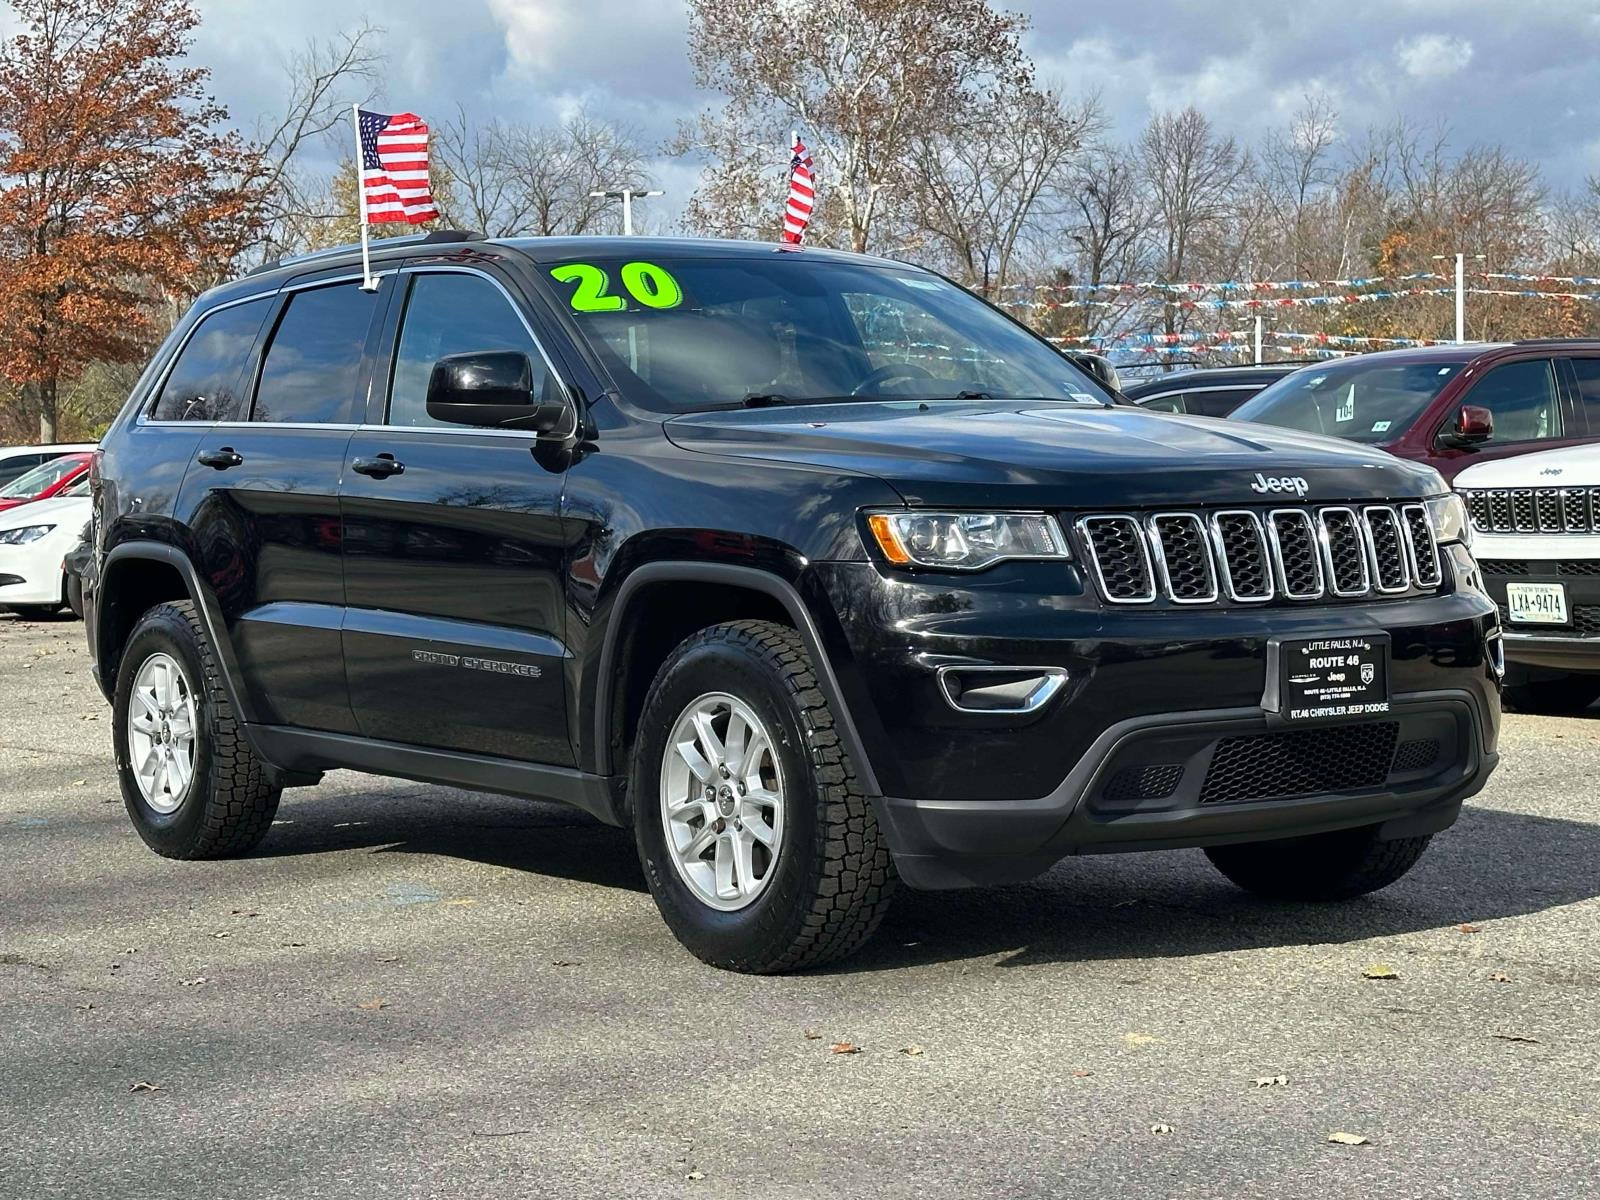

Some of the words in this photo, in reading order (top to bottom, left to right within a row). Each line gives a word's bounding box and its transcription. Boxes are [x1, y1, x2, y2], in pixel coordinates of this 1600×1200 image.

[550, 262, 684, 312] 20
[1250, 473, 1309, 497] Jeep
[1308, 641, 1330, 651] LITTLE
[1330, 640, 1352, 650] FALLS,
[411, 649, 460, 666] GRAND
[461, 656, 542, 678] CHEROKEE
[1309, 655, 1345, 669] ROUTE
[1346, 655, 1360, 666] 46
[1327, 671, 1346, 682] Jeep
[1309, 705, 1347, 718] CHRYSLER
[1346, 703, 1364, 714] JEEP
[1364, 702, 1390, 713] DODGE
